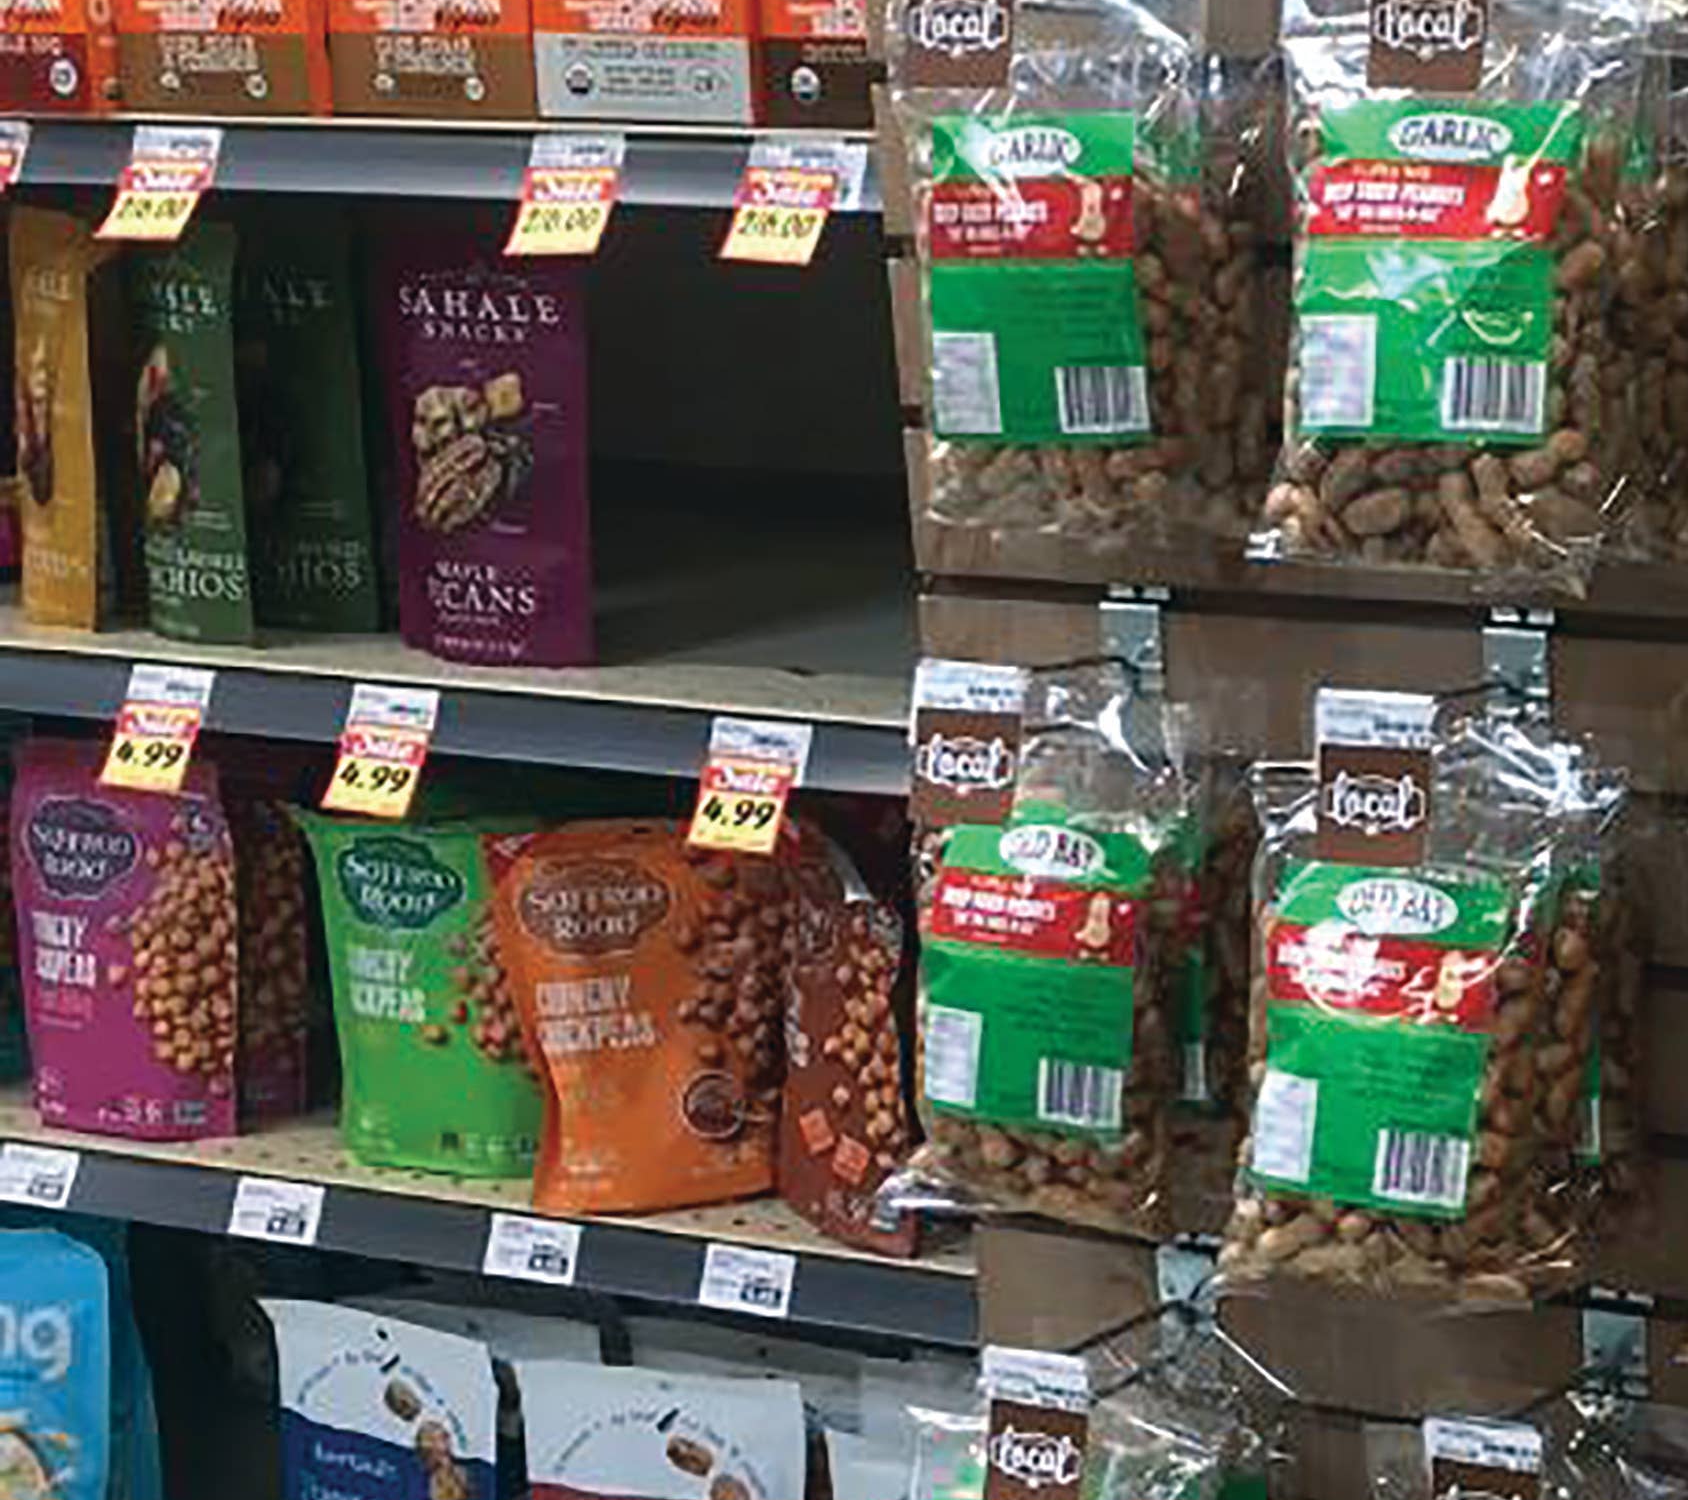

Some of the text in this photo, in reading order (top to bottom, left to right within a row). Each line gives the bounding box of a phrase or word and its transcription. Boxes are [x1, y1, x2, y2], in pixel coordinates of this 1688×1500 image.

[1401, 118, 1499, 155] GARLIC
[400, 287, 559, 324] SAHALE
[116, 742, 184, 768] 4.99
[340, 762, 411, 793] 4.99
[713, 766, 782, 794] Sale
[703, 796, 776, 830] 4.99
[1333, 771, 1413, 825] local
